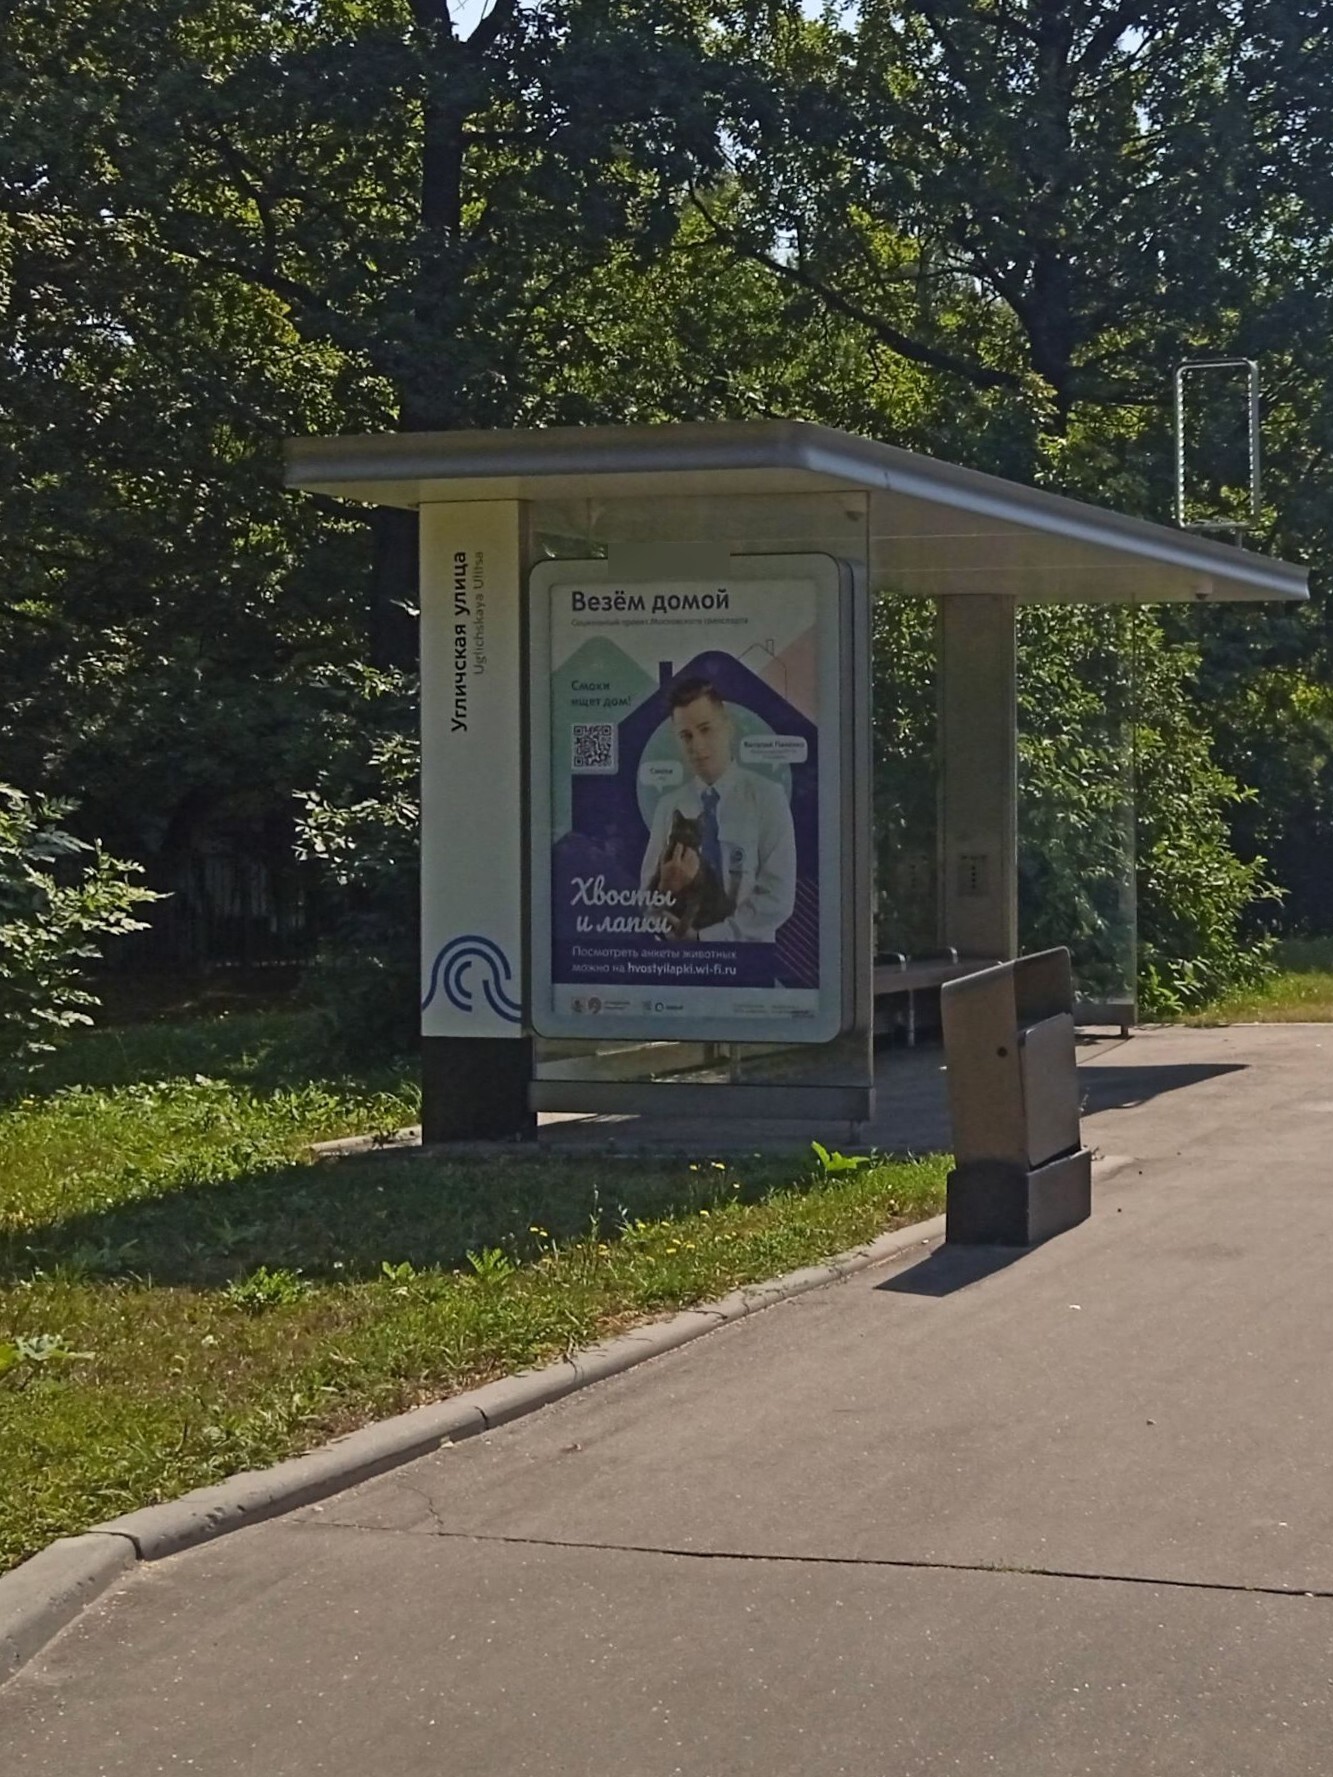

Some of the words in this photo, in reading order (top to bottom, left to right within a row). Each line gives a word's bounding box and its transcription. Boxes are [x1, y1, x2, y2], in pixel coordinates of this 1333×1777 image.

[473, 551, 484, 589] Ulitsa
[454, 551, 470, 616] улица
[571, 590, 646, 612] Везём
[652, 588, 729, 613] домой
[473, 593, 487, 675] Uglichskaya
[451, 624, 468, 732] Угличская
[571, 680, 610, 691] Смоки
[571, 696, 601, 707] ищет
[603, 695, 632, 707] дом!
[571, 874, 676, 907] Хвосты
[576, 915, 593, 932] и
[596, 915, 673, 933] лапки
[572, 945, 639, 959] Посмотреть
[640, 947, 680, 959] анкеты
[683, 948, 737, 960] животных
[571, 963, 609, 973] можно
[612, 964, 626, 973] на
